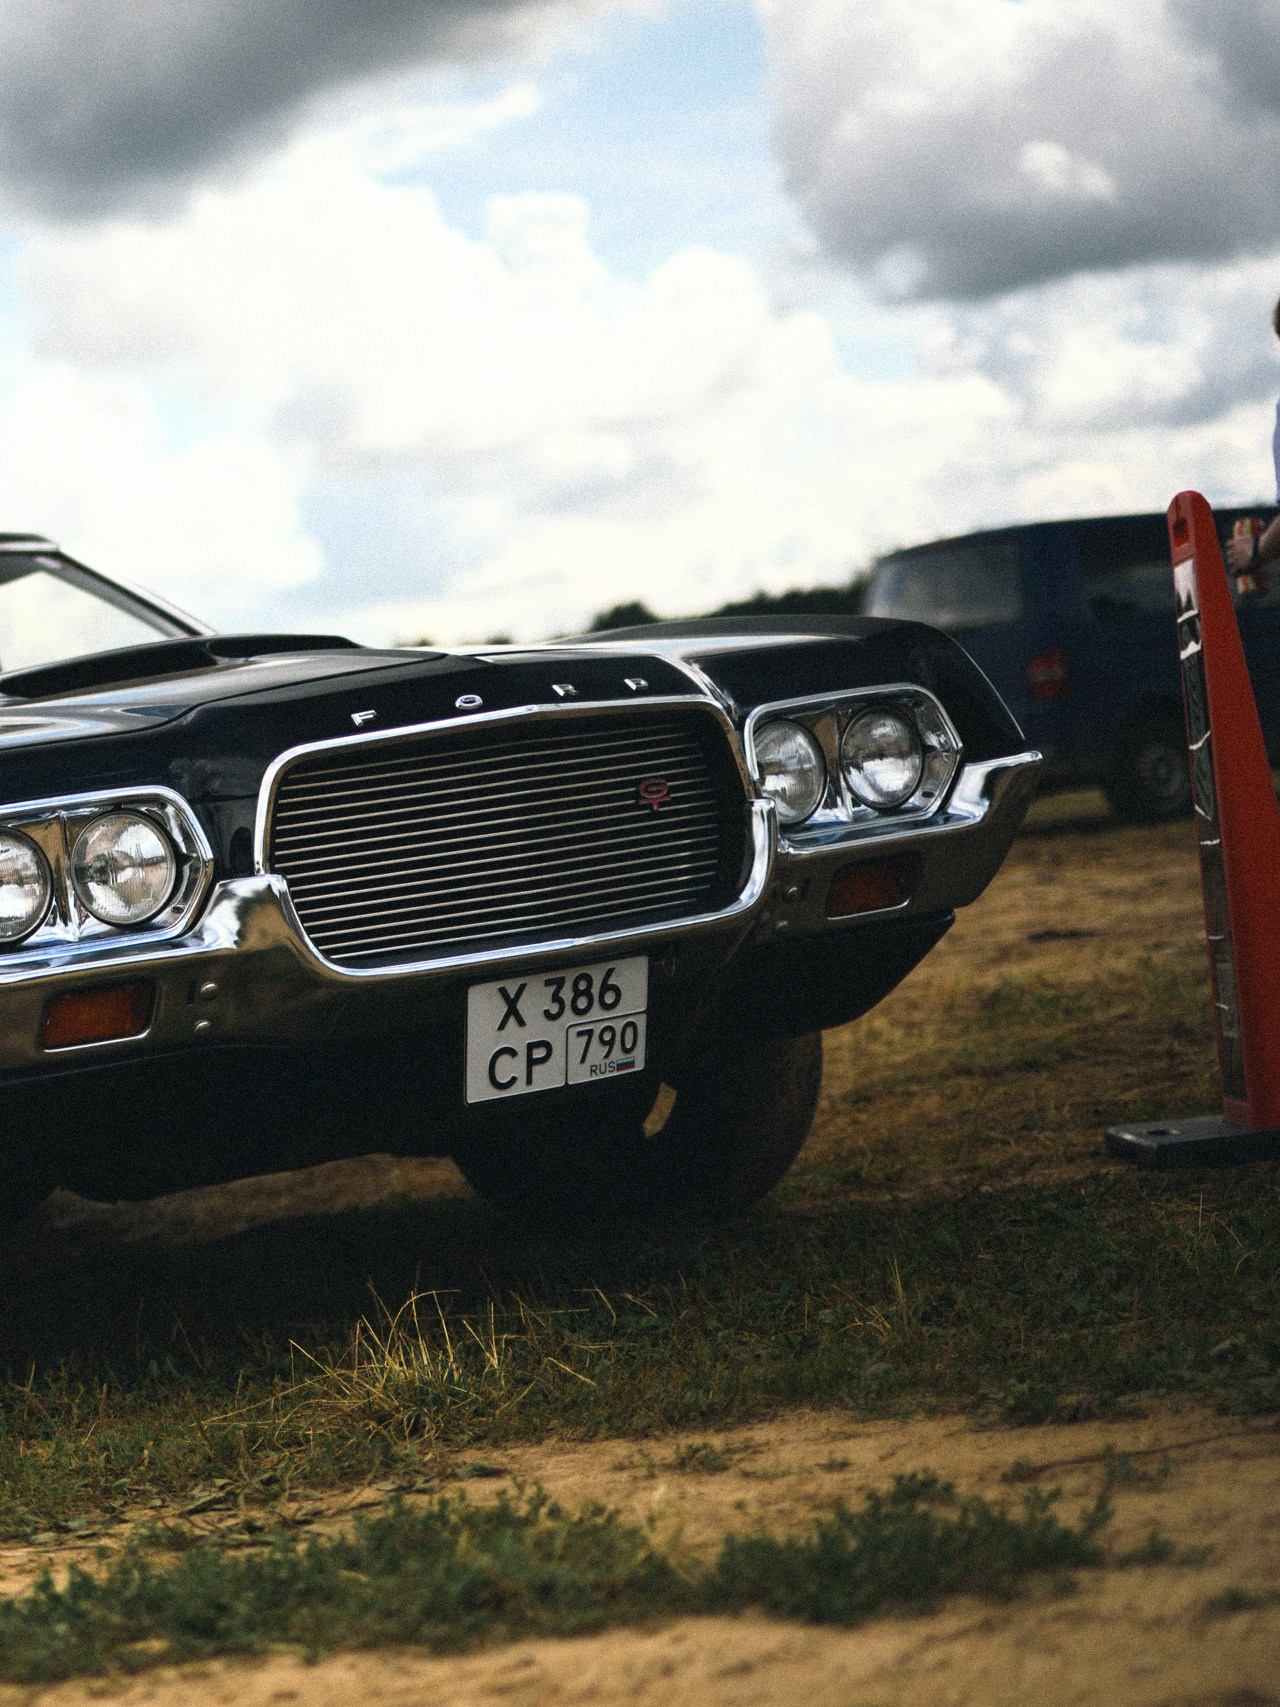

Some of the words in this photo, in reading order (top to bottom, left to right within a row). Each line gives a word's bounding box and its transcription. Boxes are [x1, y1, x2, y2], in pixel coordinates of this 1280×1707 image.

[350, 677, 649, 727] FORD
[496, 982, 528, 1032] X
[542, 966, 622, 1022] 386
[488, 1039, 554, 1091] CP
[576, 1020, 639, 1065] 790
[589, 1061, 616, 1077] RUS
